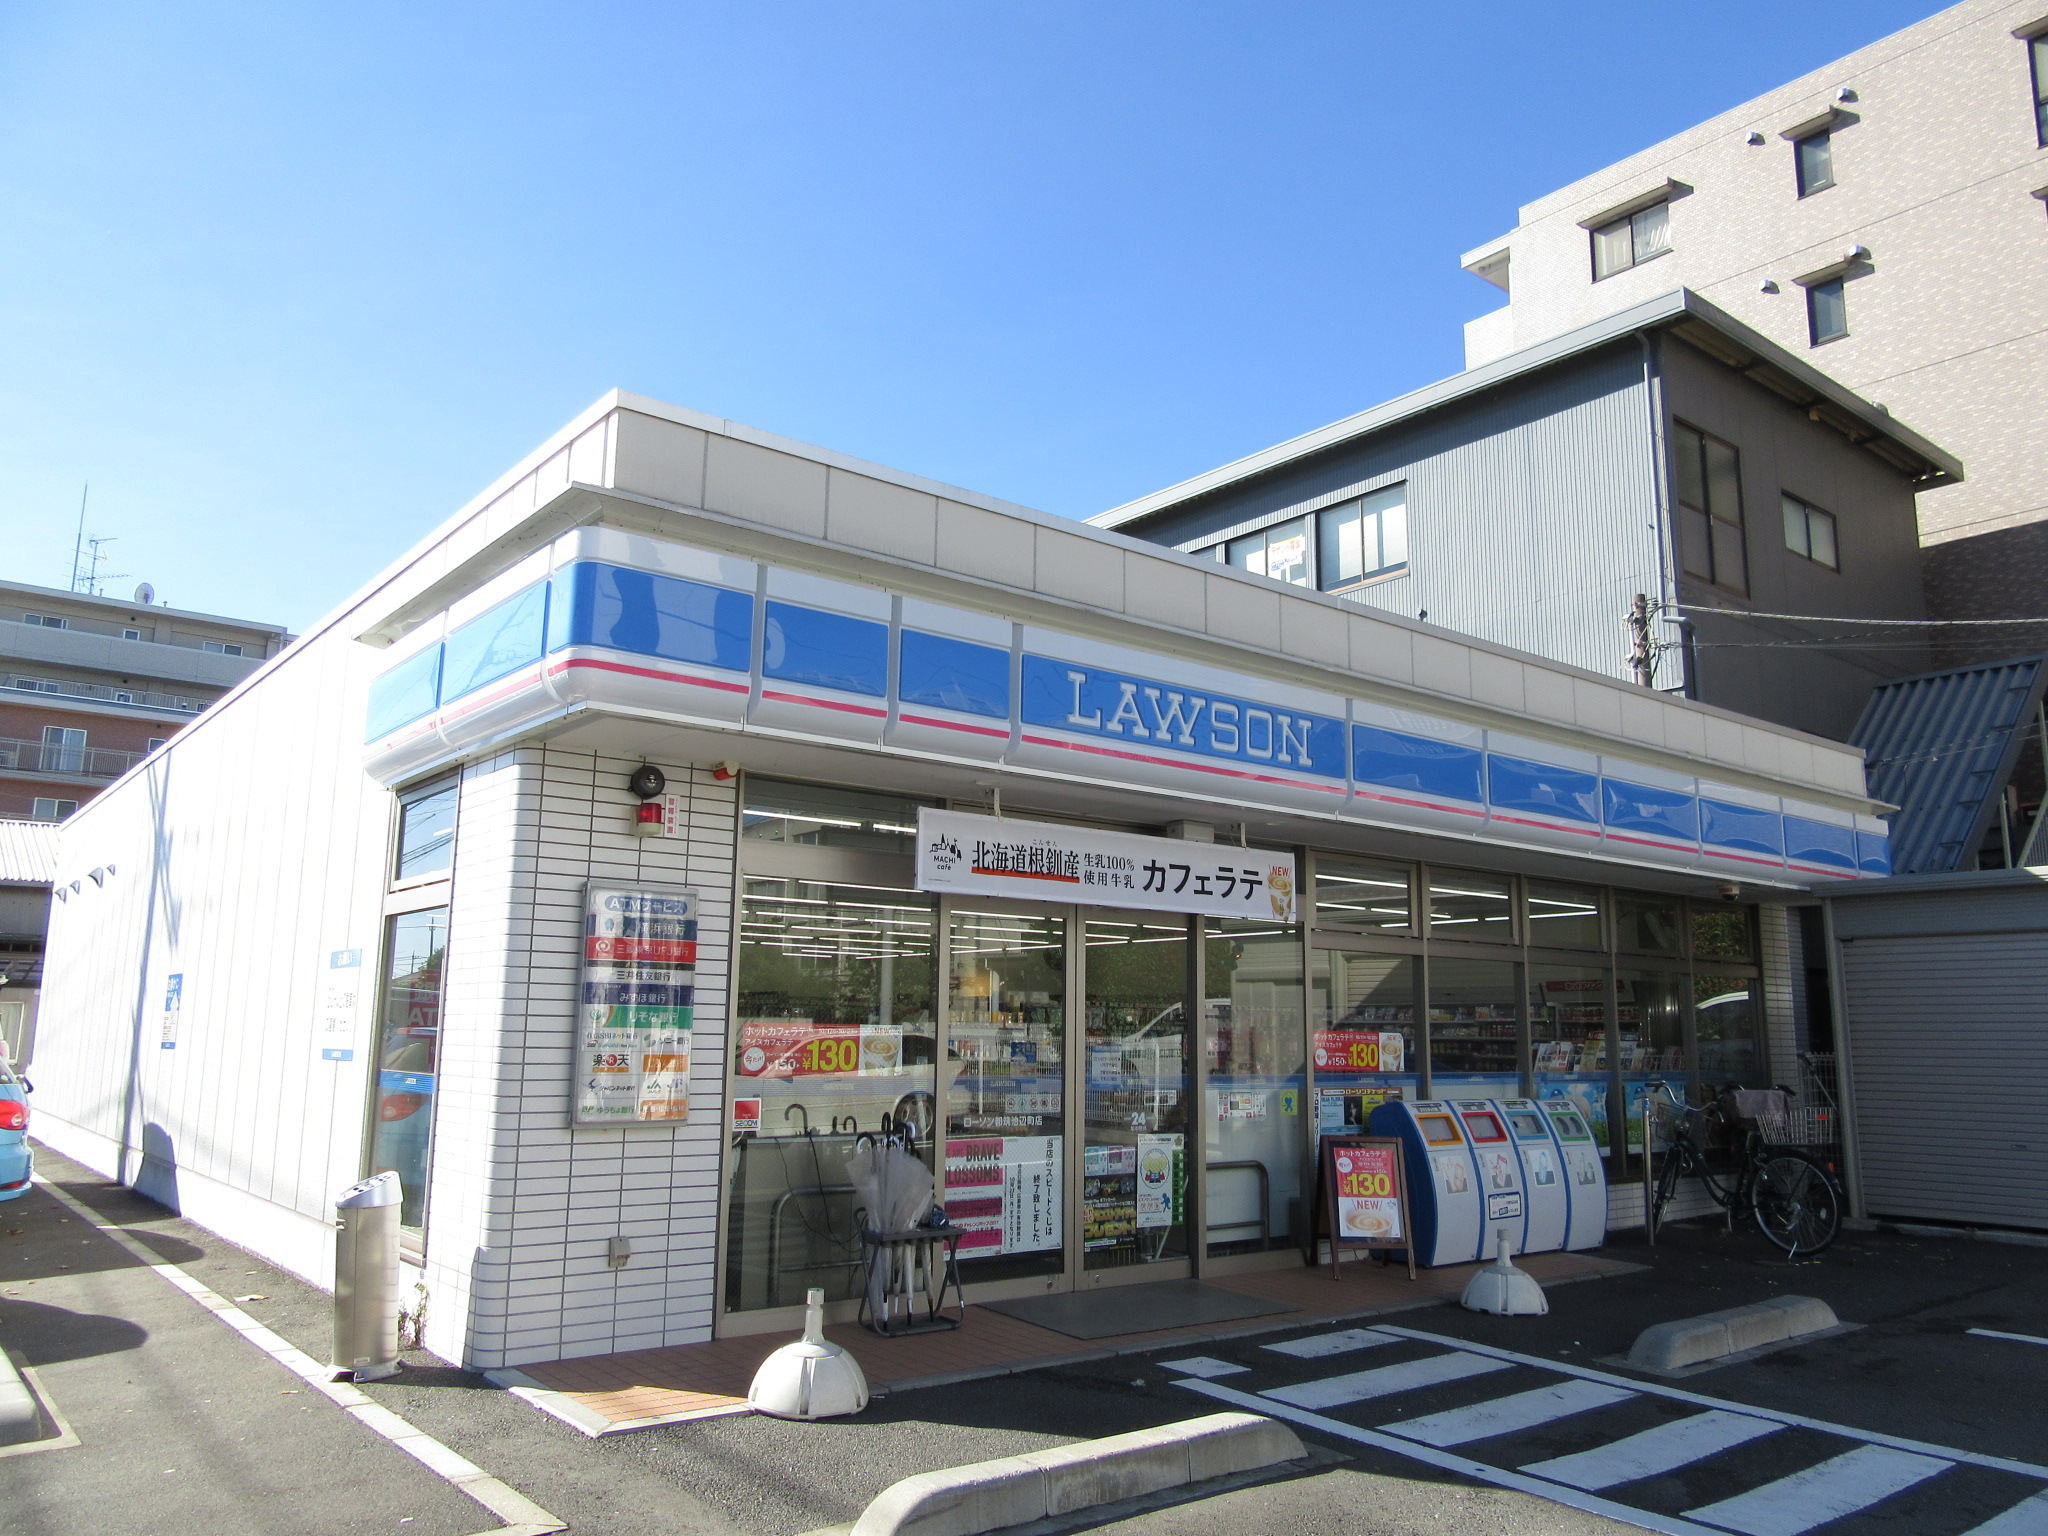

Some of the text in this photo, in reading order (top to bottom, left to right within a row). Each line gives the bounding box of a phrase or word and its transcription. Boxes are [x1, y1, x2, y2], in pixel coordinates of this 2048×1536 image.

[1067, 670, 1313, 767] LAWSON
[1031, 838, 1058, 848] こんせん
[933, 855, 956, 864] MACHI
[971, 840, 1080, 880] 北海道根釧産
[1083, 852, 1135, 872] 生乳100%
[1142, 859, 1263, 900] カフェラテ
[1272, 866, 1289, 877] NEW
[1083, 871, 1135, 890] 使用牛乳
[609, 897, 683, 914] ATMサービス
[616, 970, 671, 982] 三井住友銀行
[619, 992, 666, 1003] みずほ銀行
[596, 1105, 635, 1115] ゆうちょ銀行
[735, 1119, 757, 1127] SECOM
[1131, 1111, 1146, 1126] 24
[966, 1143, 1001, 1162] BRAVE
[945, 1163, 1001, 1185] LOSSOMS
[1045, 1138, 1054, 1236] 当店のスピードくじは
[1356, 1200, 1380, 1210] NEW
